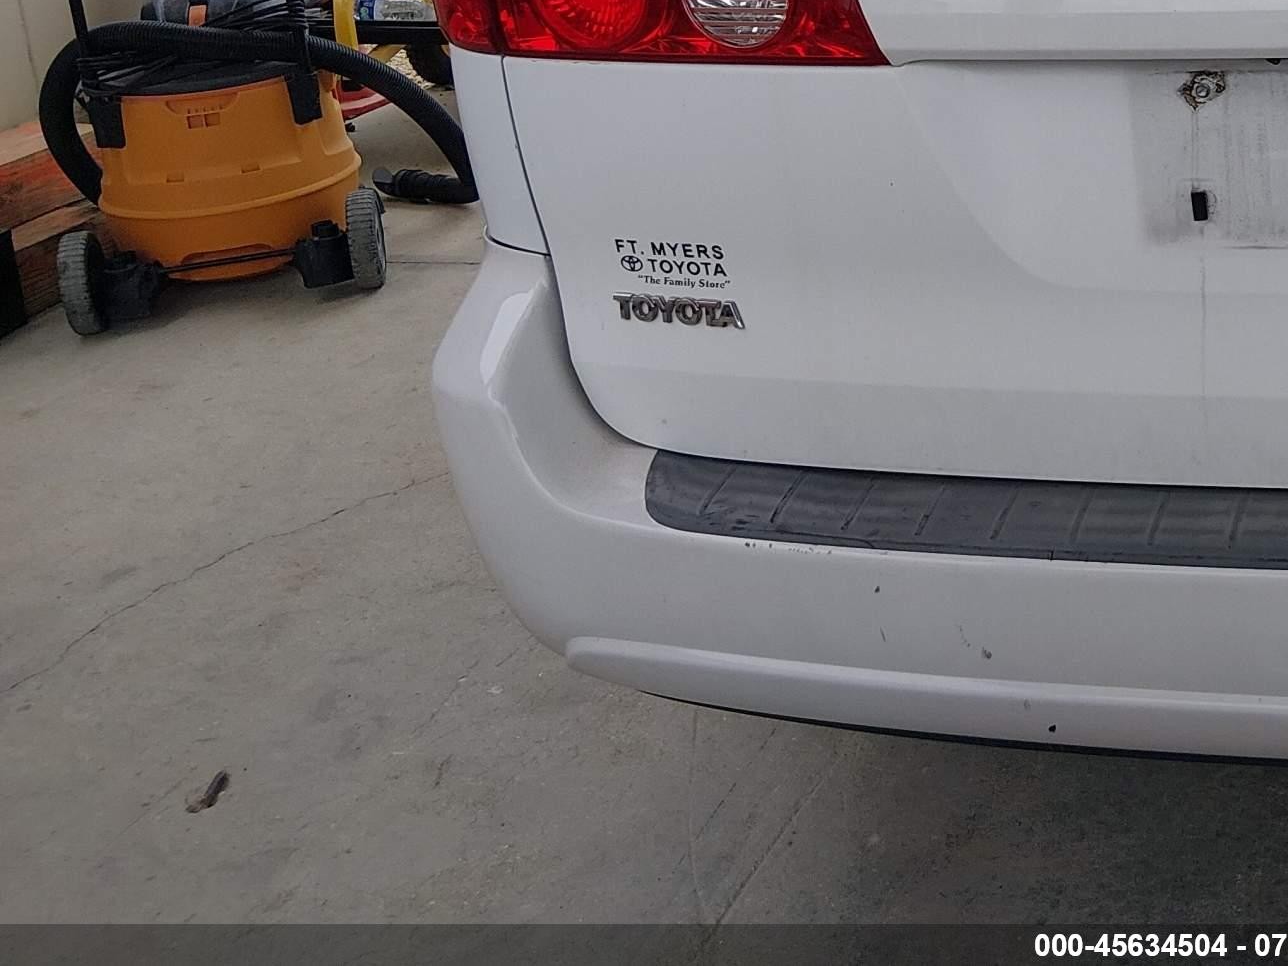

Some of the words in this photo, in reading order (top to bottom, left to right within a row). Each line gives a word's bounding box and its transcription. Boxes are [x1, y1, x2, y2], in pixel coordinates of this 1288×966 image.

[614, 238, 645, 255] FT.
[650, 241, 725, 260] MYERS
[647, 258, 728, 277] TOYOTA
[663, 276, 696, 289] Family
[612, 291, 746, 330] TOYOTA
